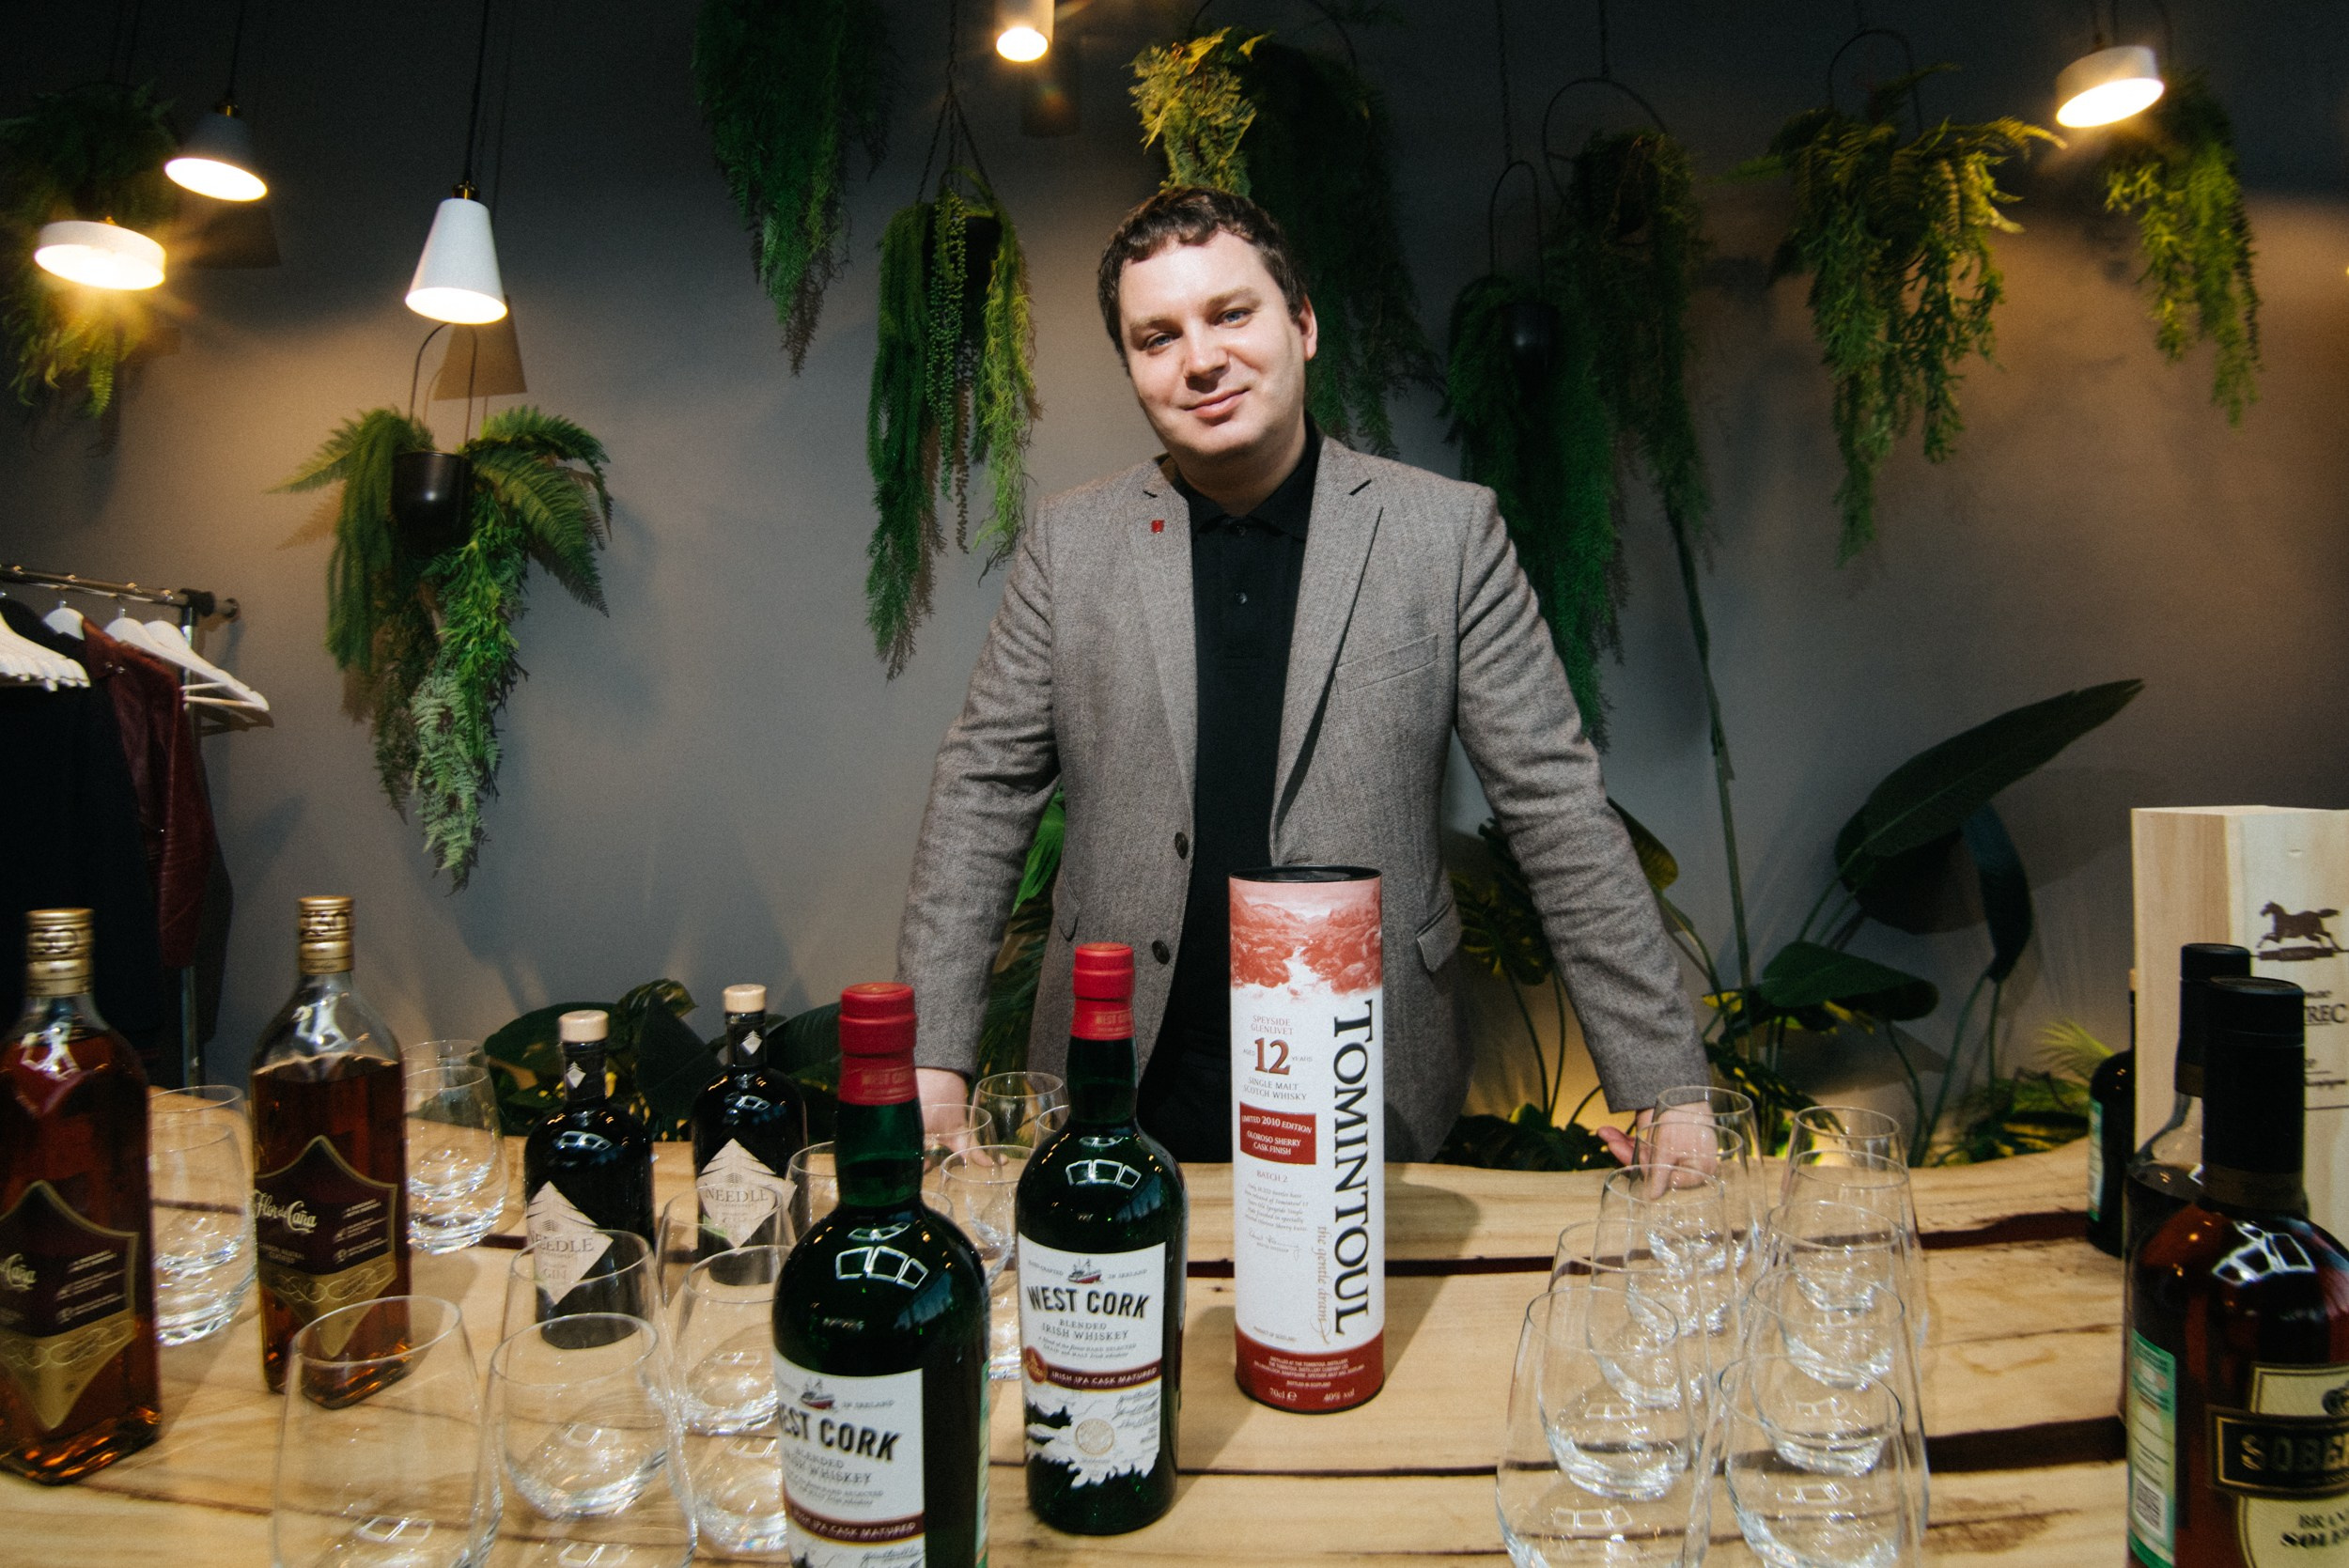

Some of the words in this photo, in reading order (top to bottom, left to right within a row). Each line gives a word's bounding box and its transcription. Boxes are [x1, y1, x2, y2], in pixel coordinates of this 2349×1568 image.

[1252, 1015, 1291, 1026] SPEYSIDE
[2304, 1003, 2347, 1024] REC
[1251, 1024, 1294, 1035] GLENLIVET
[1254, 1037, 1291, 1076] 12
[1243, 1084, 1269, 1098] SCOTCH
[1272, 1091, 1307, 1101] WHISKY
[1248, 1077, 1272, 1089] SINGLE
[1275, 1081, 1299, 1091] MALT
[1241, 1114, 1261, 1124] LIMITED
[1261, 1115, 1281, 1126] 2010
[1282, 1121, 1313, 1134] EDITION
[1247, 1130, 1273, 1144] OLOROSO
[1274, 1136, 1301, 1147] SHERRY
[1253, 1141, 1269, 1152] CASK
[1269, 1145, 1292, 1156] FINISH
[1256, 1170, 1281, 1182] BATCH
[1333, 999, 1373, 1335] TOMINTOUL
[254, 1188, 279, 1219] Flor
[287, 1200, 318, 1234] Caña
[1317, 1225, 1331, 1245] the
[1312, 1246, 1331, 1285] gentle
[1026, 1285, 1078, 1312] WEST
[1087, 1290, 1150, 1319] CORK
[1041, 1322, 1070, 1338] IRISH
[1074, 1329, 1129, 1342] WHISKEY
[1059, 1318, 1107, 1330] BLENDED
[1051, 1370, 1072, 1382] IRISH
[1074, 1374, 1090, 1384] IPA
[1091, 1374, 1115, 1385] CASK
[1117, 1367, 1158, 1384] MATURED
[1269, 1388, 1285, 1399] 70cl
[1323, 1390, 1342, 1402] 40%
[1343, 1388, 1355, 1398] vol
[779, 1402, 810, 1440] EST
[819, 1417, 902, 1462] CORK
[809, 1462, 872, 1484] WHISKEY
[860, 1521, 916, 1539] MATURED
